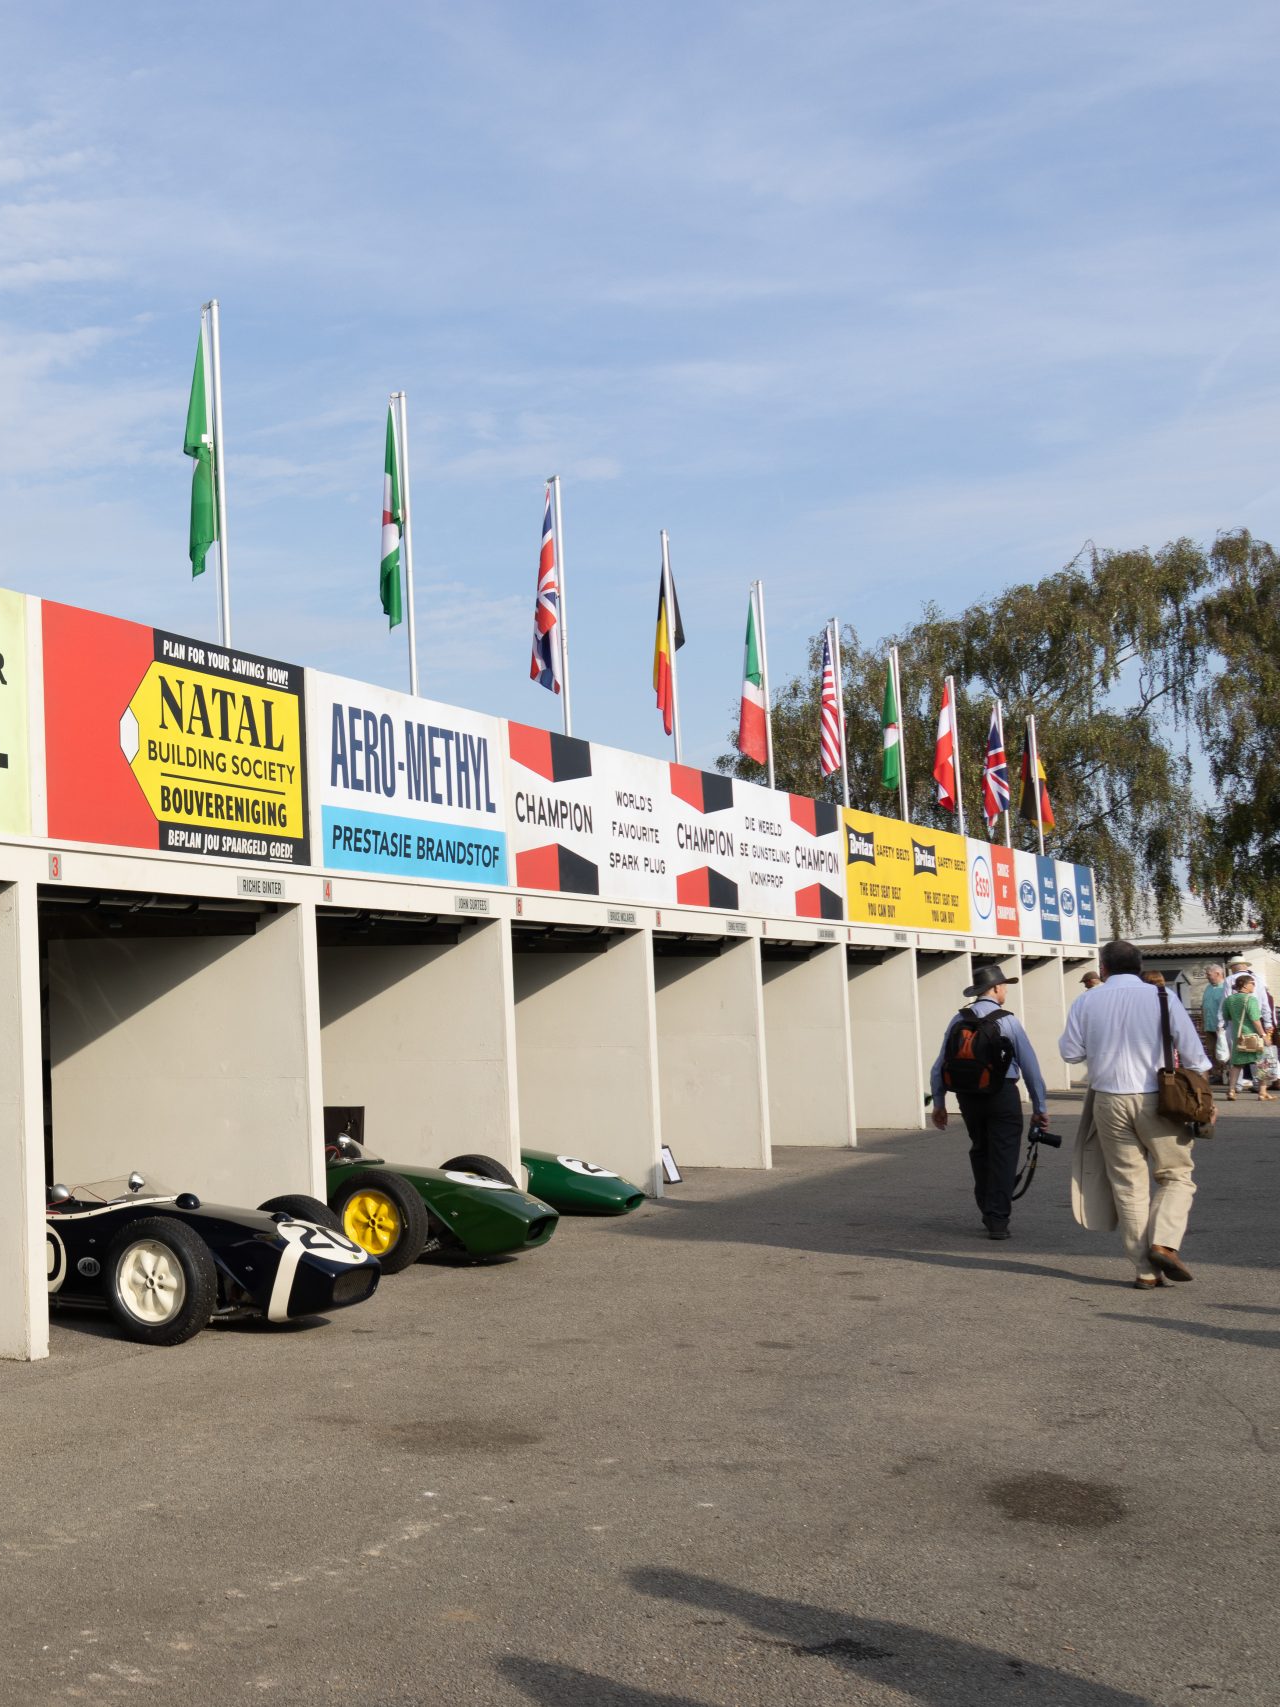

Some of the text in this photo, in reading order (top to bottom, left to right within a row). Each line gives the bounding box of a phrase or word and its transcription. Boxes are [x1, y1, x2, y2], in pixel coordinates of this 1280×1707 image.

[163, 640, 289, 684] PLAN FOR YOUR SAVINGS NOW!
[158, 674, 285, 753] NATAL
[148, 739, 296, 785] BUILDING SOCIETY
[331, 702, 497, 814] AERO-METHYL
[160, 786, 288, 829] BOUVERENIGING
[515, 791, 594, 834] CHAMPION
[615, 789, 653, 813] WORLD'S
[611, 821, 660, 845] FAVOURITE
[745, 816, 783, 837] DIE WERELD
[167, 829, 294, 860] BEPLAN JOU SPAARGELD GOED!
[332, 824, 500, 869] PRESTASIE BRANDSTOF
[676, 822, 734, 858] CHAMPION
[849, 833, 910, 861] Britax SAFETY BELTS
[609, 852, 666, 874] SPARK PLUG
[740, 842, 791, 864] SE GUNSTELING
[795, 845, 839, 875] CHAMPION
[914, 846, 936, 868] Britax
[52, 857, 60, 877] 3
[242, 879, 282, 895] RICHIE GINTER
[325, 883, 331, 899] 4
[749, 871, 784, 889] VONKPROP
[860, 881, 901, 900] THE BEST SEAT BELT
[975, 871, 990, 898] Esso
[1022, 884, 1034, 905] Ford
[1062, 892, 1073, 911] Ford
[868, 902, 896, 918] YOU CAN BUY
[281, 1223, 363, 1254] 20
